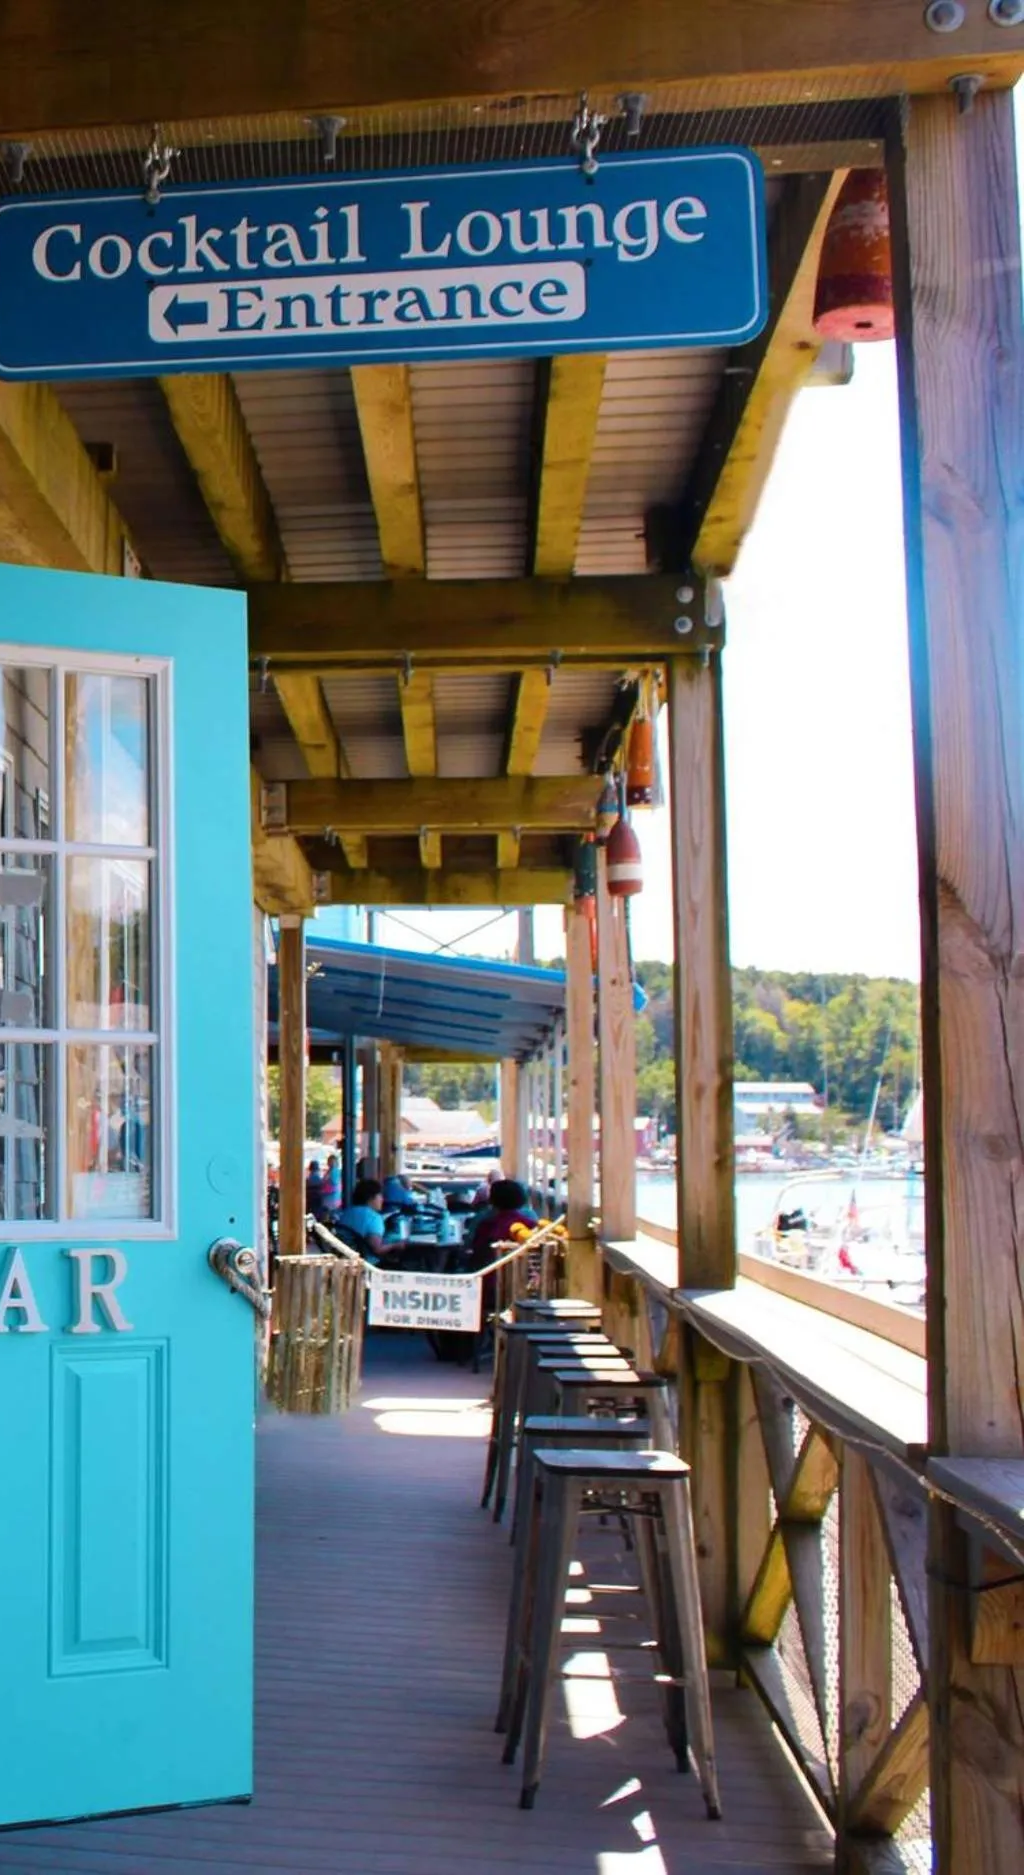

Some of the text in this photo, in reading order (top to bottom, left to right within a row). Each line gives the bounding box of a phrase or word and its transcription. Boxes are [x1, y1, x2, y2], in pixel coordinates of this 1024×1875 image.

[32, 196, 706, 281] Cocktail Lounge
[218, 278, 569, 332] Entrance
[382, 1290, 461, 1312] INSIDE
[385, 1313, 461, 1327] FOR DINING
